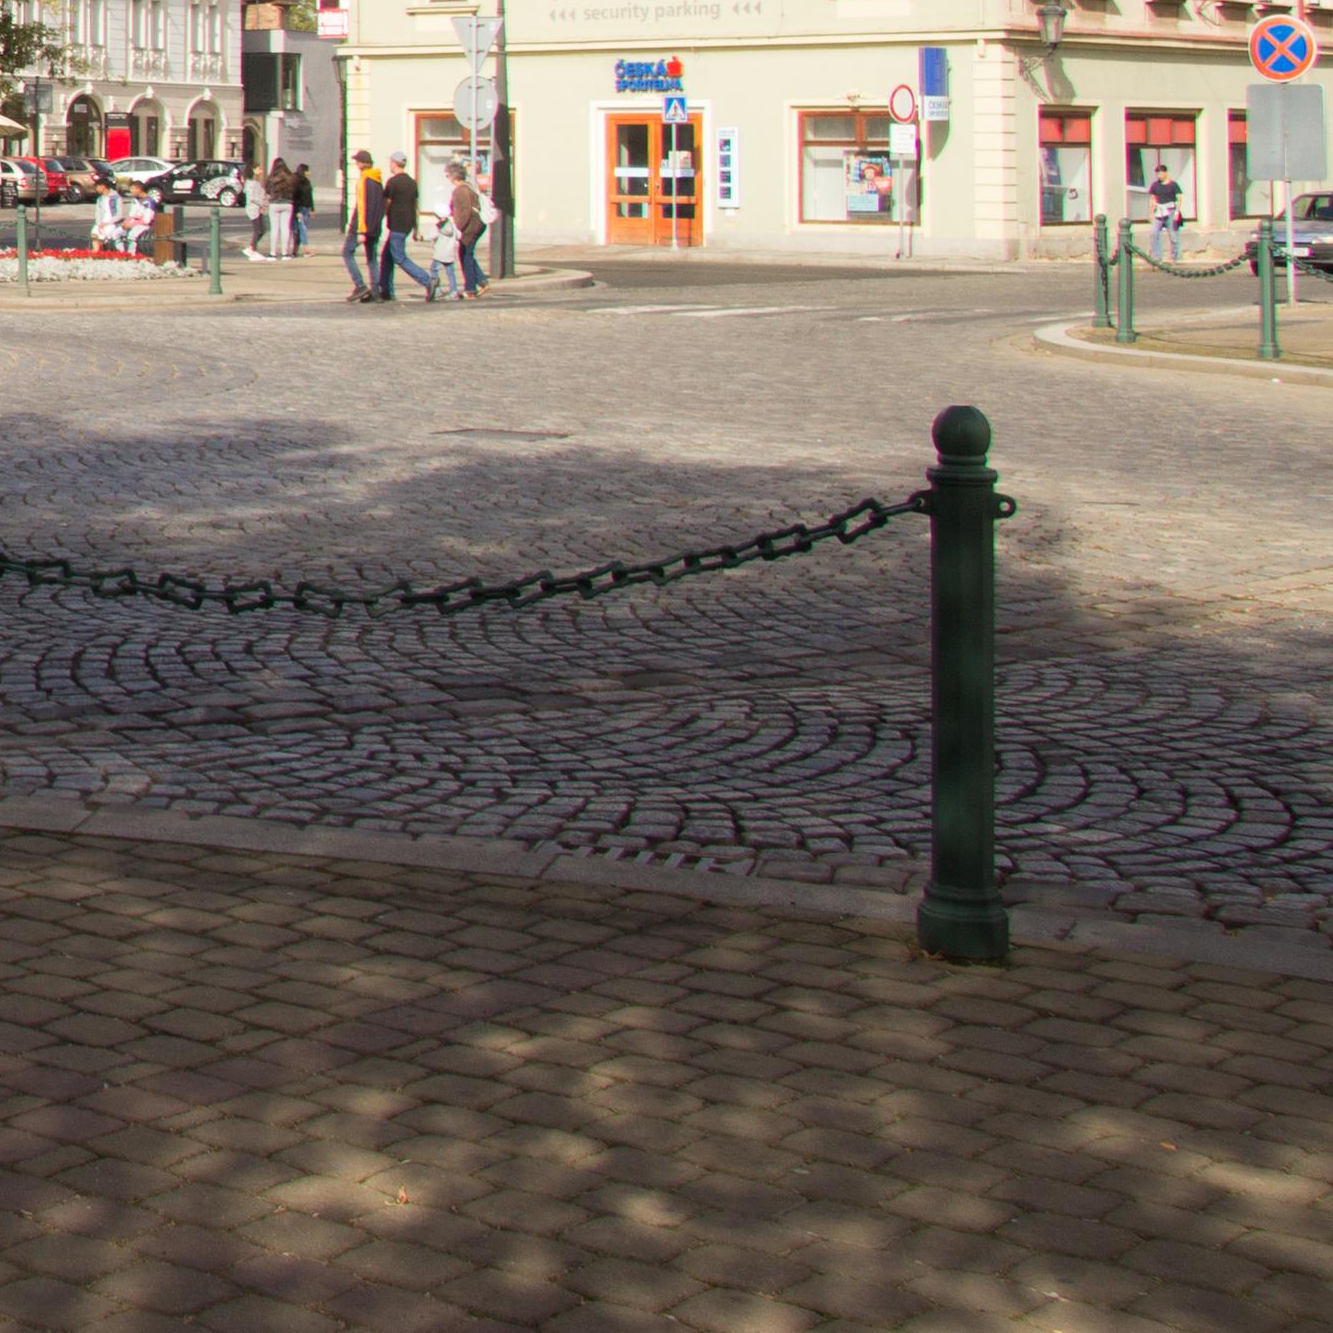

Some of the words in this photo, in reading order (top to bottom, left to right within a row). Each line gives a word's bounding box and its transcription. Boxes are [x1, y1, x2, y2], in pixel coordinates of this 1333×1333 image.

[584, 2, 650, 20] security
[655, 1, 721, 20] parking
[615, 58, 667, 78] ČESKÁ
